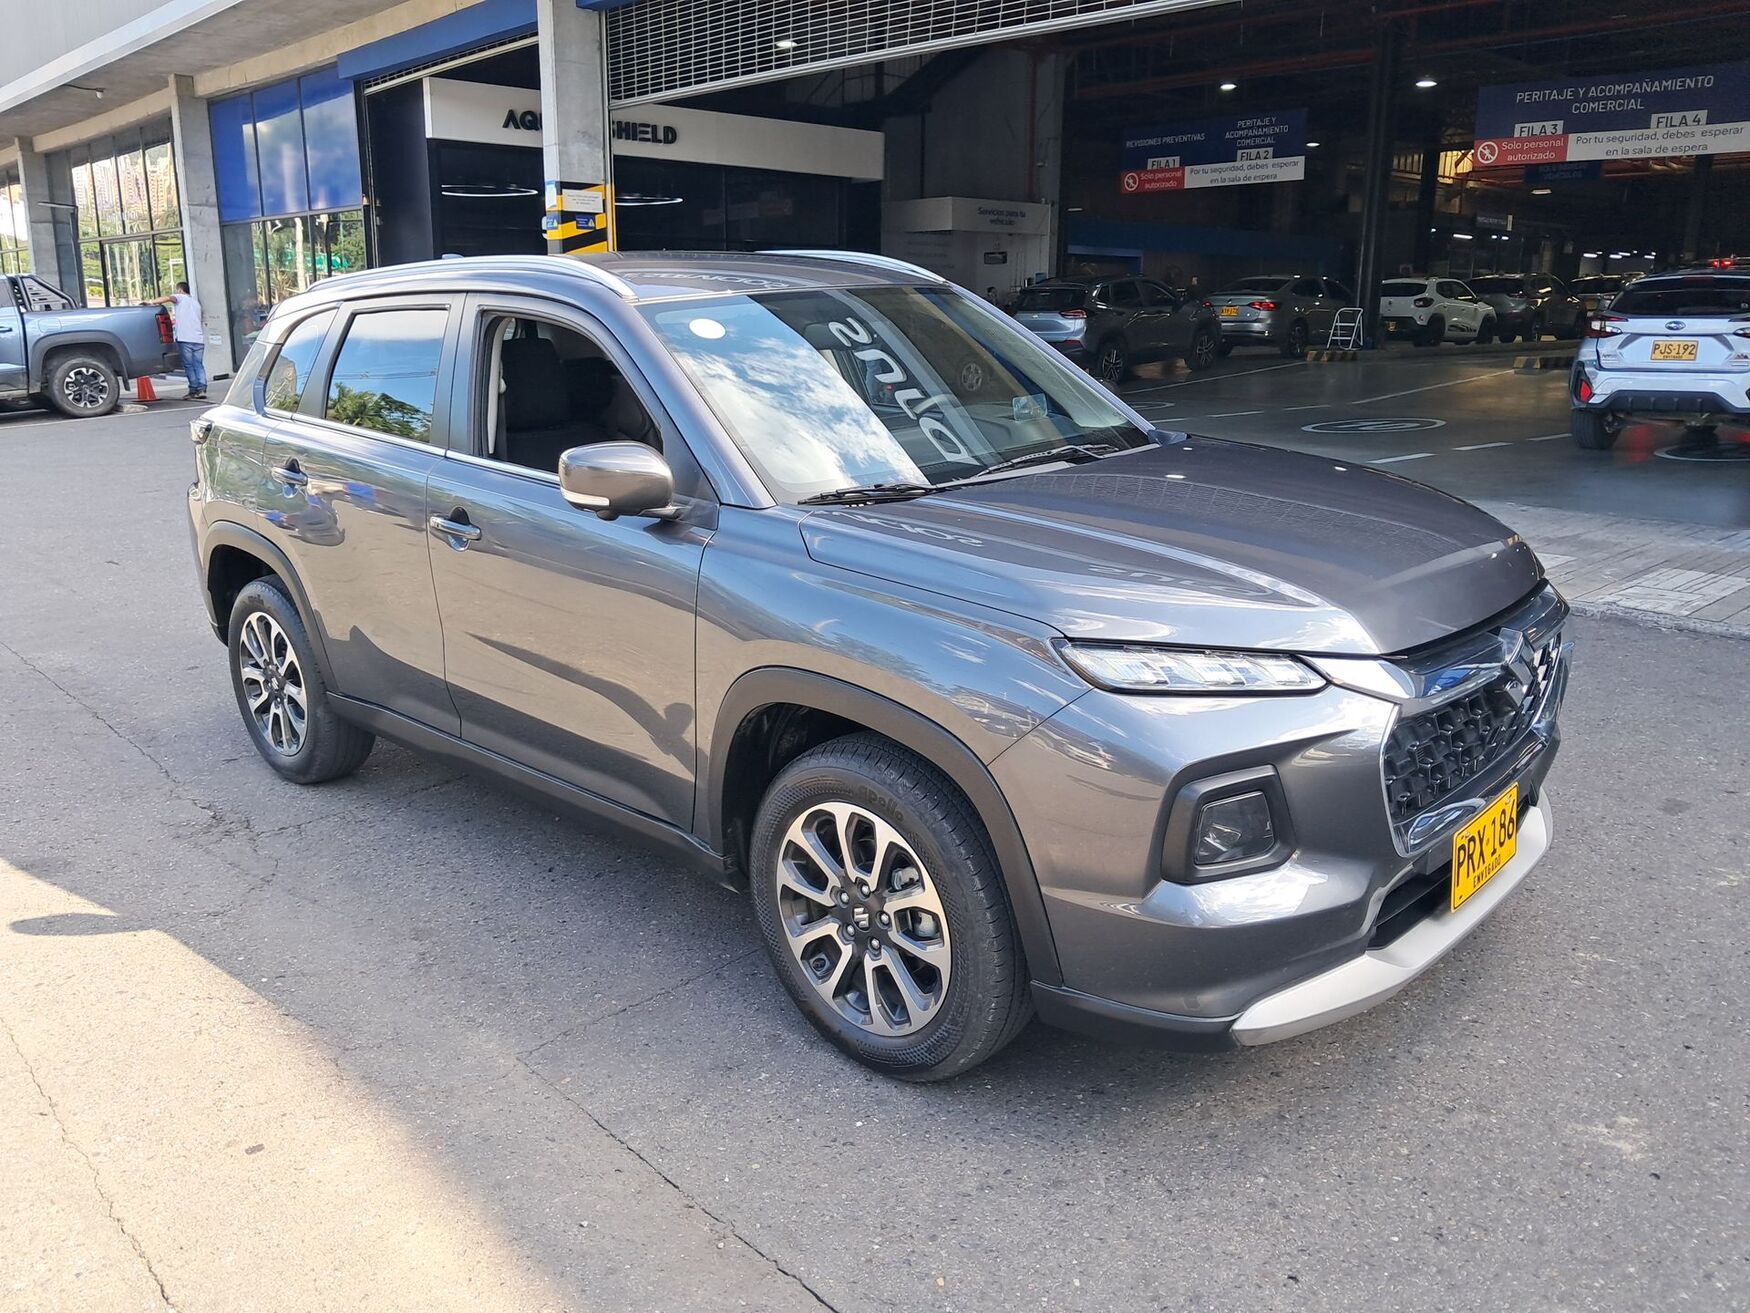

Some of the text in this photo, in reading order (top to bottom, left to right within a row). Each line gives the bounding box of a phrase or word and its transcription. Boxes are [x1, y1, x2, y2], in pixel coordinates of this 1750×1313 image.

[1516, 75, 1714, 104] PERITAJE Y ACOMPAÑAMIENTO
[1571, 98, 1645, 114] COMERCIAL
[502, 109, 542, 131] AQ
[1237, 116, 1277, 129] PERITAJE Y
[1656, 113, 1702, 129] FILA 4
[1225, 125, 1289, 139] ACOMPAÑAMIENTO
[1519, 123, 1558, 138] FILA 3
[1576, 126, 1745, 146] Por tu seguridad, debes esperar
[1126, 133, 1205, 148] REVISIONES PREVENTIVAS
[1236, 136, 1276, 148] COMERCIAL
[1501, 138, 1564, 152] Solo personal
[1240, 150, 1270, 162] FILA 2
[1507, 150, 1556, 162] autorizado
[1605, 142, 1708, 157] en la sala de espera
[1151, 159, 1172, 170] FILA
[1190, 160, 1299, 176] Por tu seguridad, debes esperar
[1140, 170, 1182, 182] Solo personal
[1210, 173, 1278, 185] en la sala de espera
[1145, 181, 1177, 190] autorizado
[1473, 854, 1501, 889] ENVIGADO
